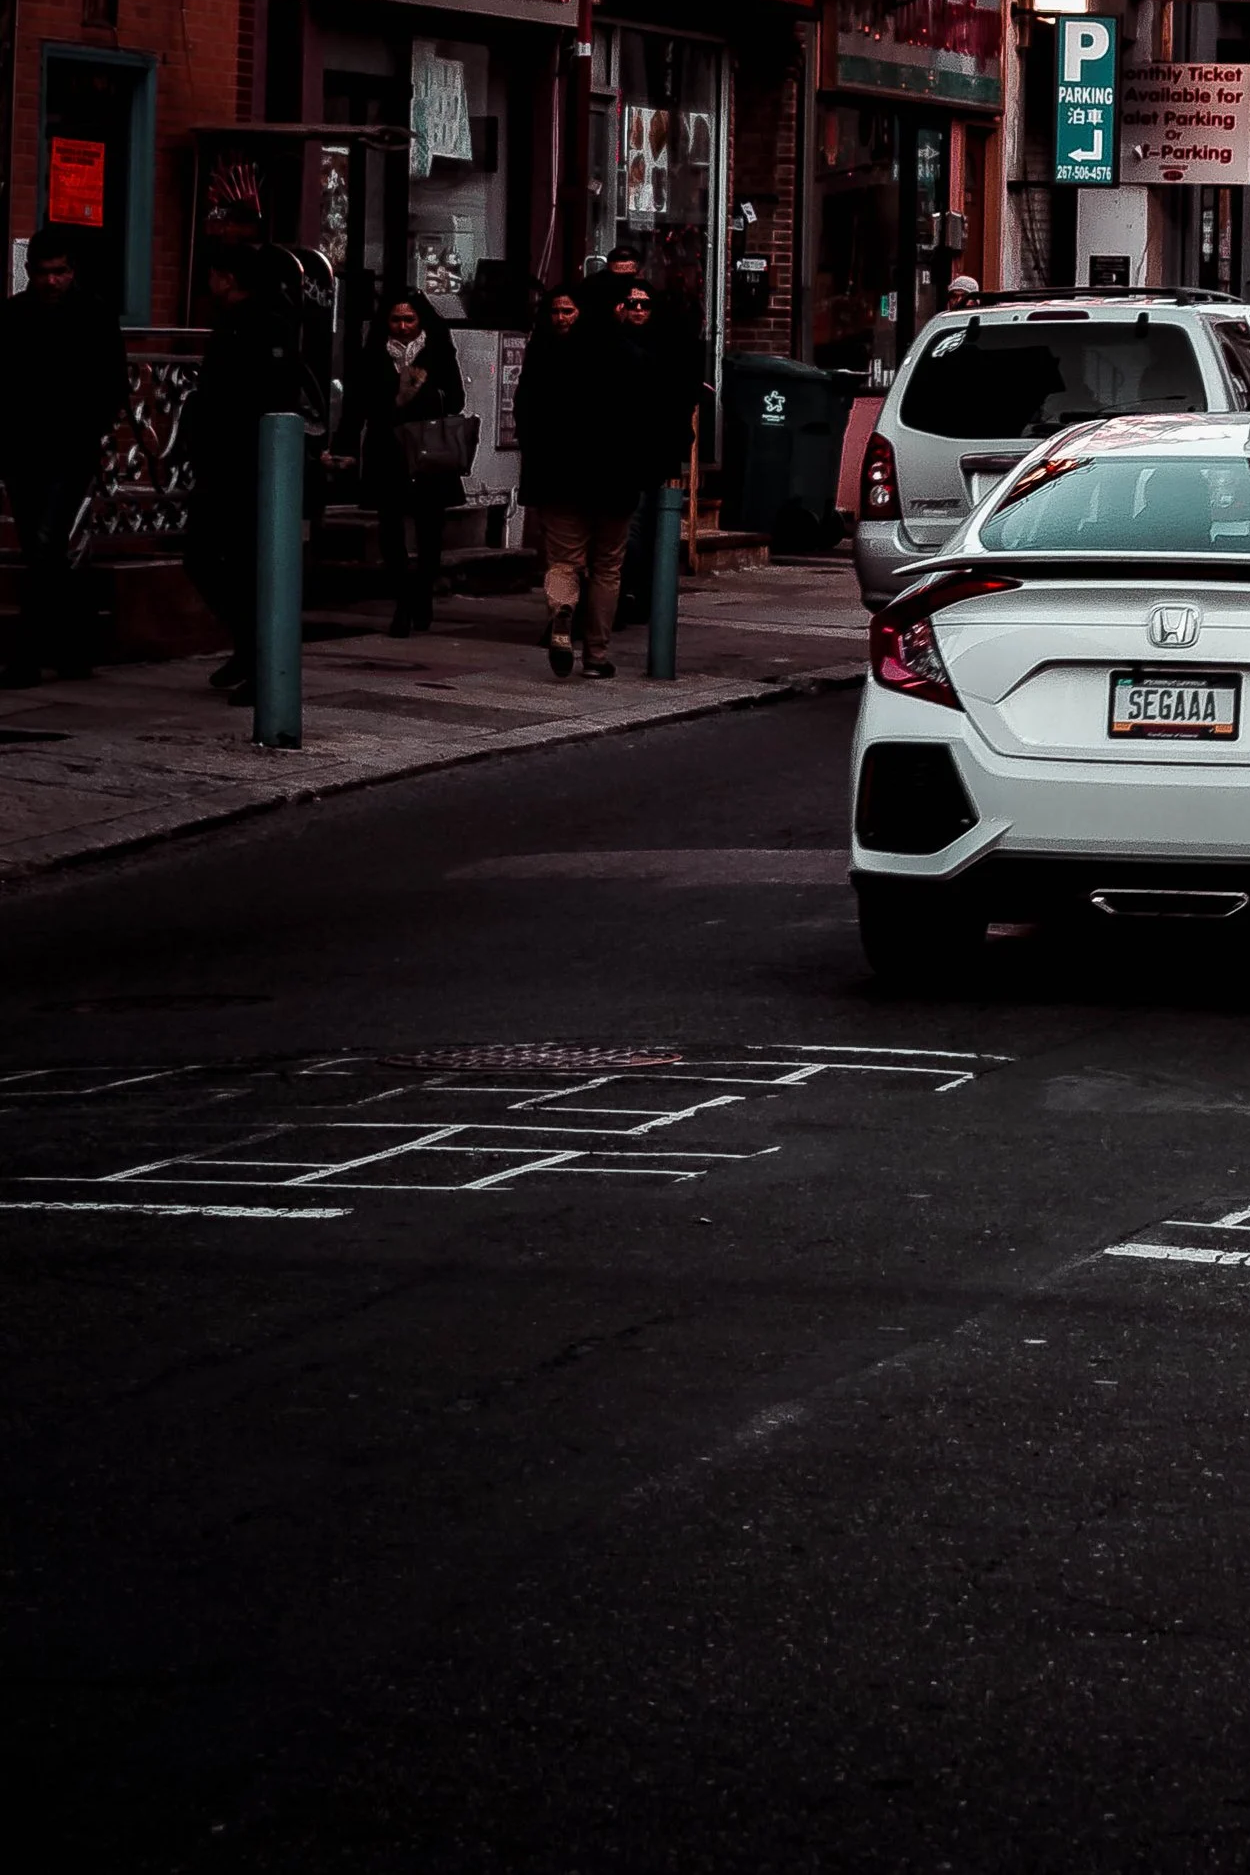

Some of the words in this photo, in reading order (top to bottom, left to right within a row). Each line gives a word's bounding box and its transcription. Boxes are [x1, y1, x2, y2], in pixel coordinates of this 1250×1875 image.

[1063, 21, 1110, 82] P
[1125, 66, 1183, 84] onthly
[1188, 66, 1243, 82] Ticket
[1058, 87, 1113, 105] PARKING
[1124, 87, 1211, 103] Available
[1217, 88, 1243, 103] for
[1067, 108, 1104, 125] 泊車
[1120, 110, 1158, 125] alet
[1165, 111, 1236, 131] Parking
[1165, 130, 1183, 140] Or
[1056, 165, 1112, 181] 267-506-4576
[1128, 689, 1216, 722] SEGAAA
